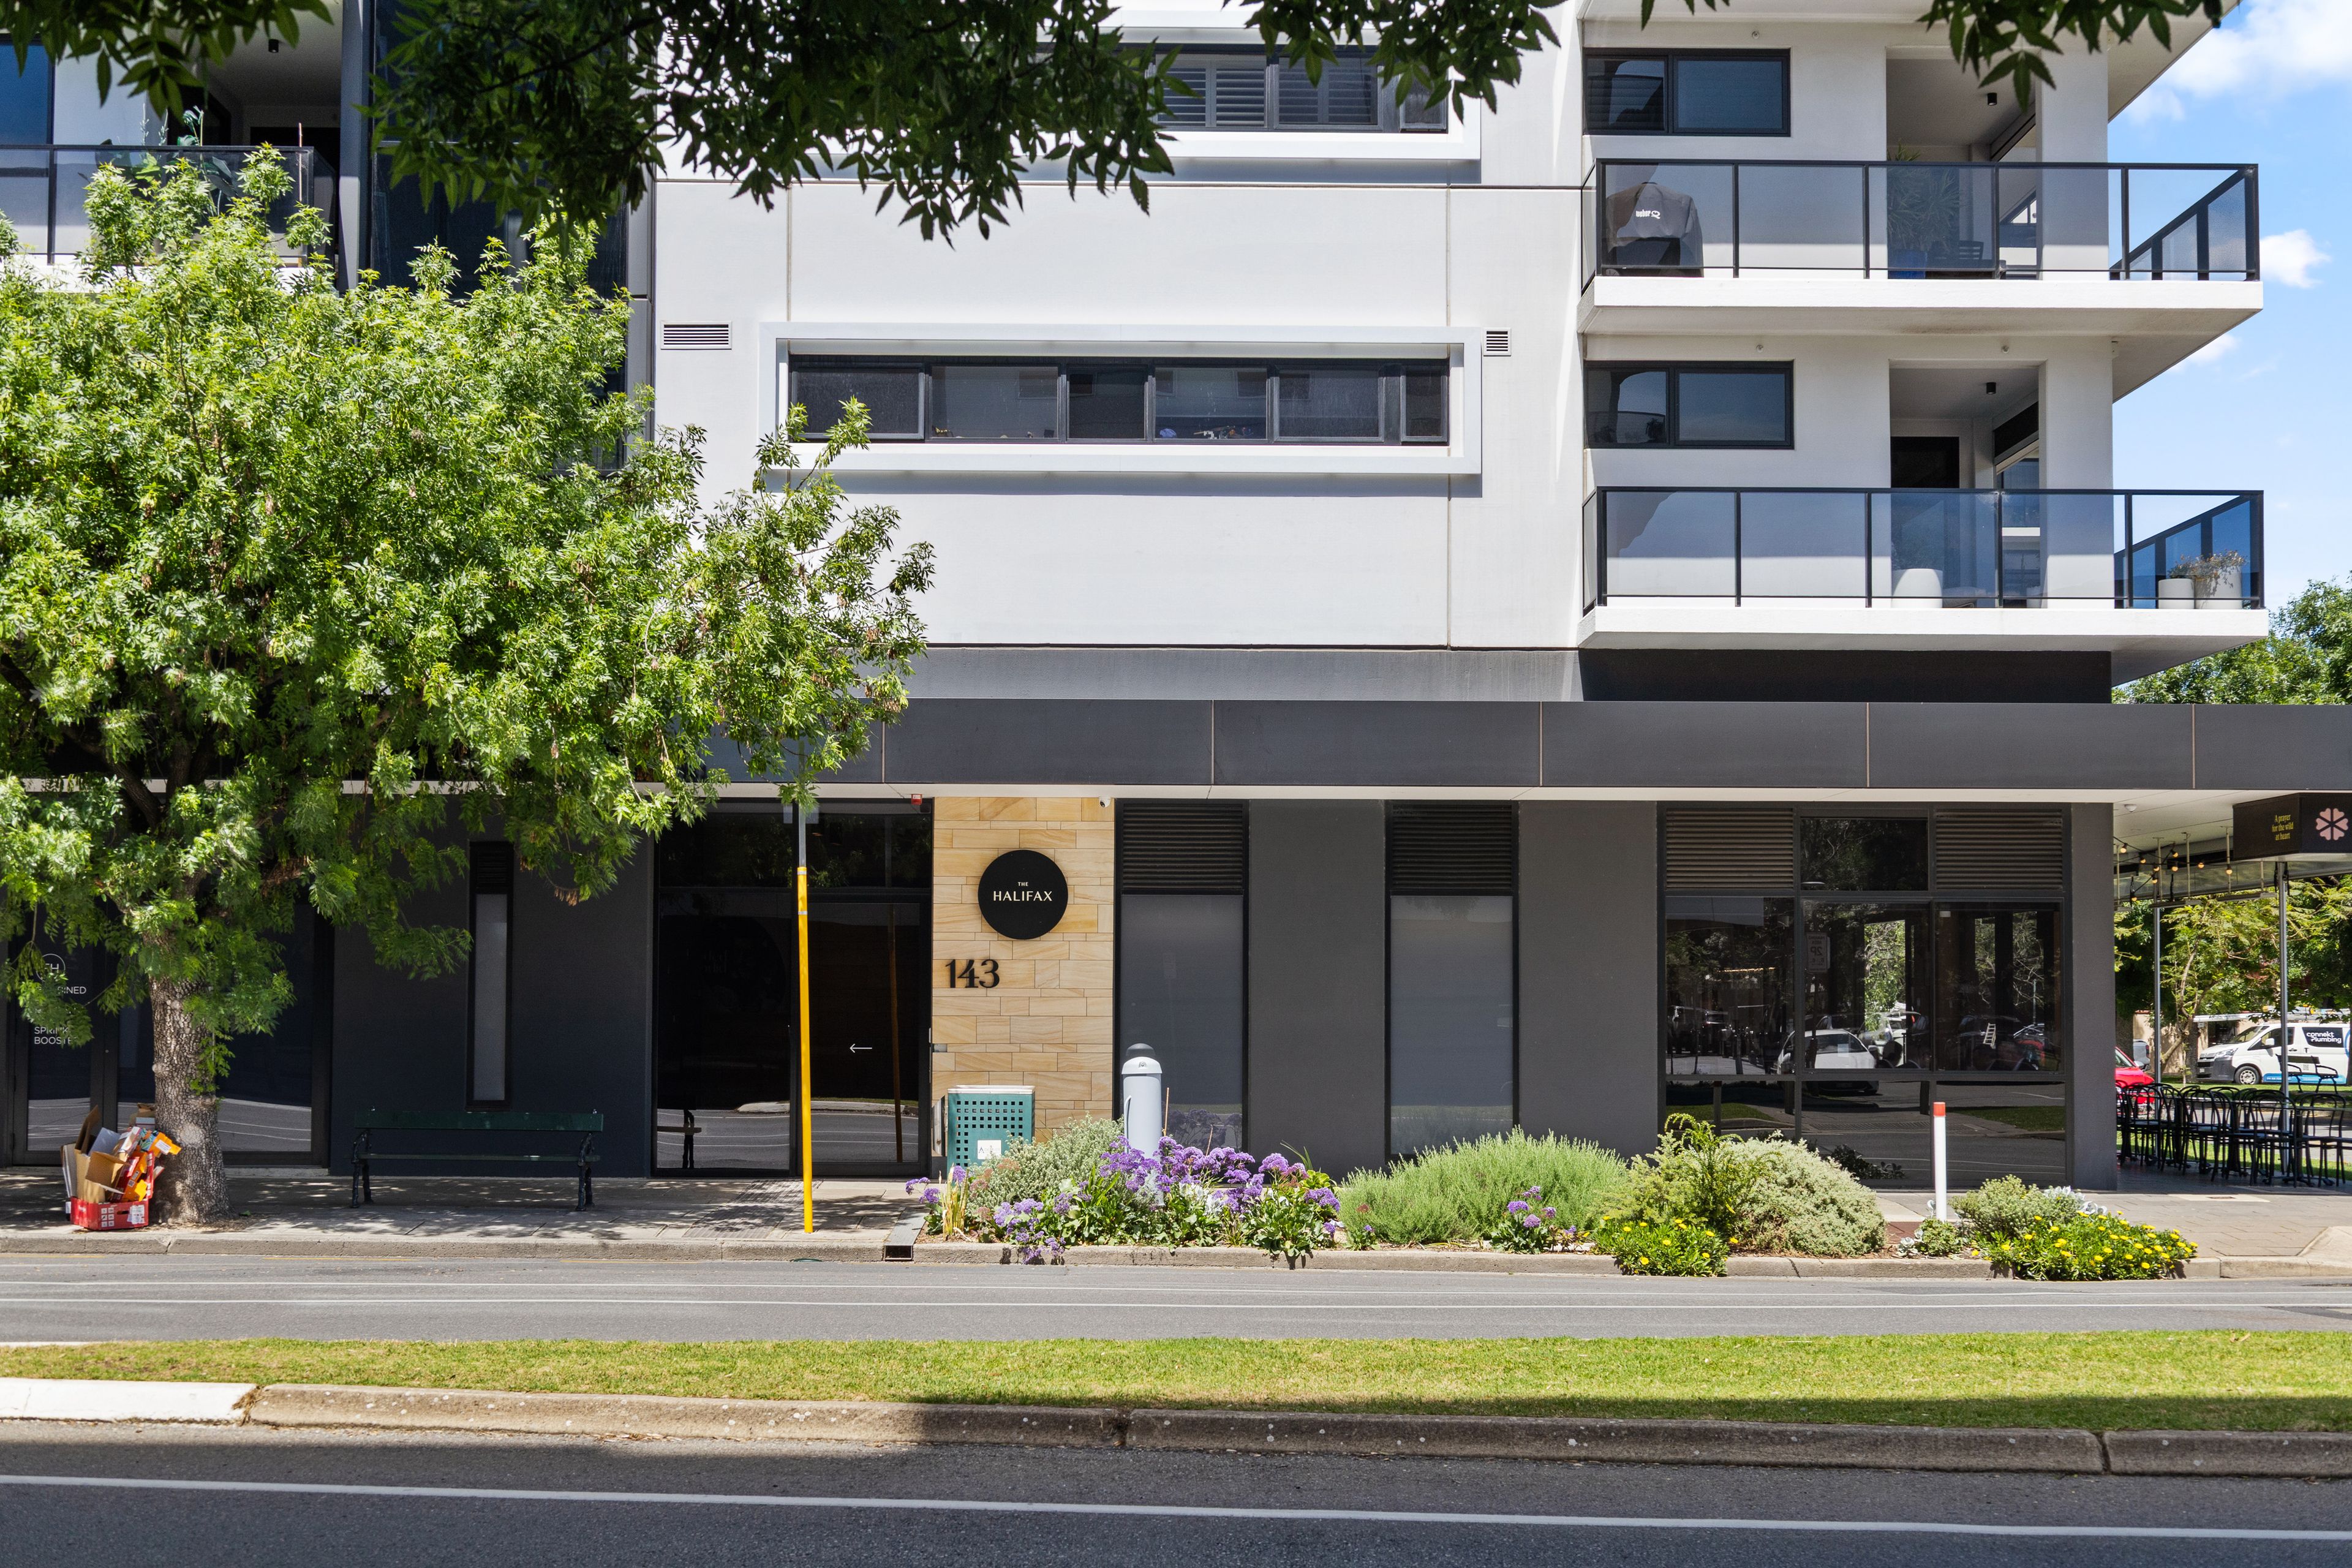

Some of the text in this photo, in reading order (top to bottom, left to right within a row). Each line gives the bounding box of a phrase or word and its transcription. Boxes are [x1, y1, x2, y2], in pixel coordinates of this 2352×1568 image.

[1636, 209, 1651, 217] weber
[993, 891, 1052, 901] HALIFAX
[945, 959, 1000, 988] 143
